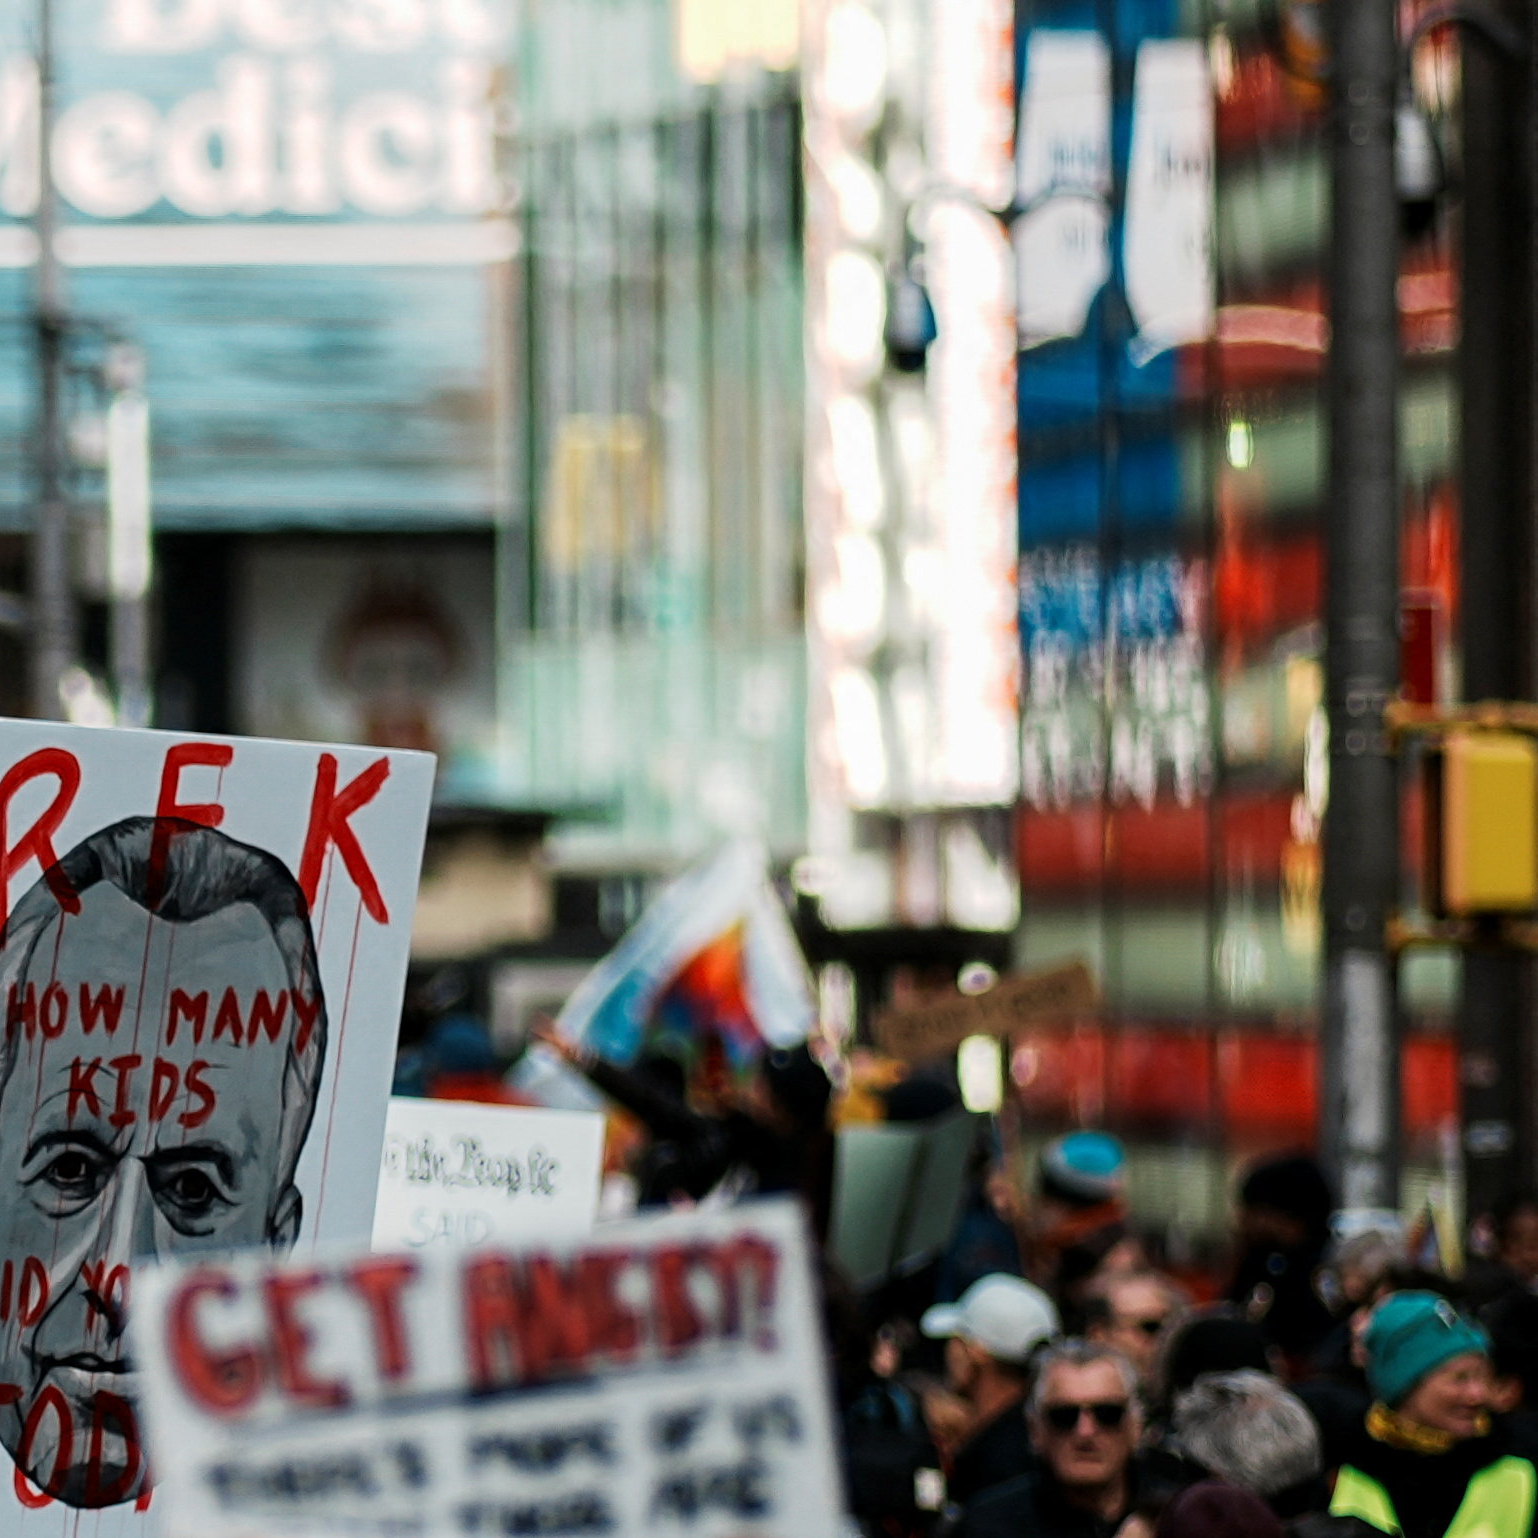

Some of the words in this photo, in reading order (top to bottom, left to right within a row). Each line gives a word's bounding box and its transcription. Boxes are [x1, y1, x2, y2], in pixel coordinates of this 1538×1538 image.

[6, 980, 126, 1042] HOW
[166, 987, 319, 1055] MANY
[66, 1053, 217, 1128] KIDS
[82, 1258, 132, 1333] YO
[167, 1253, 421, 1421] GET
